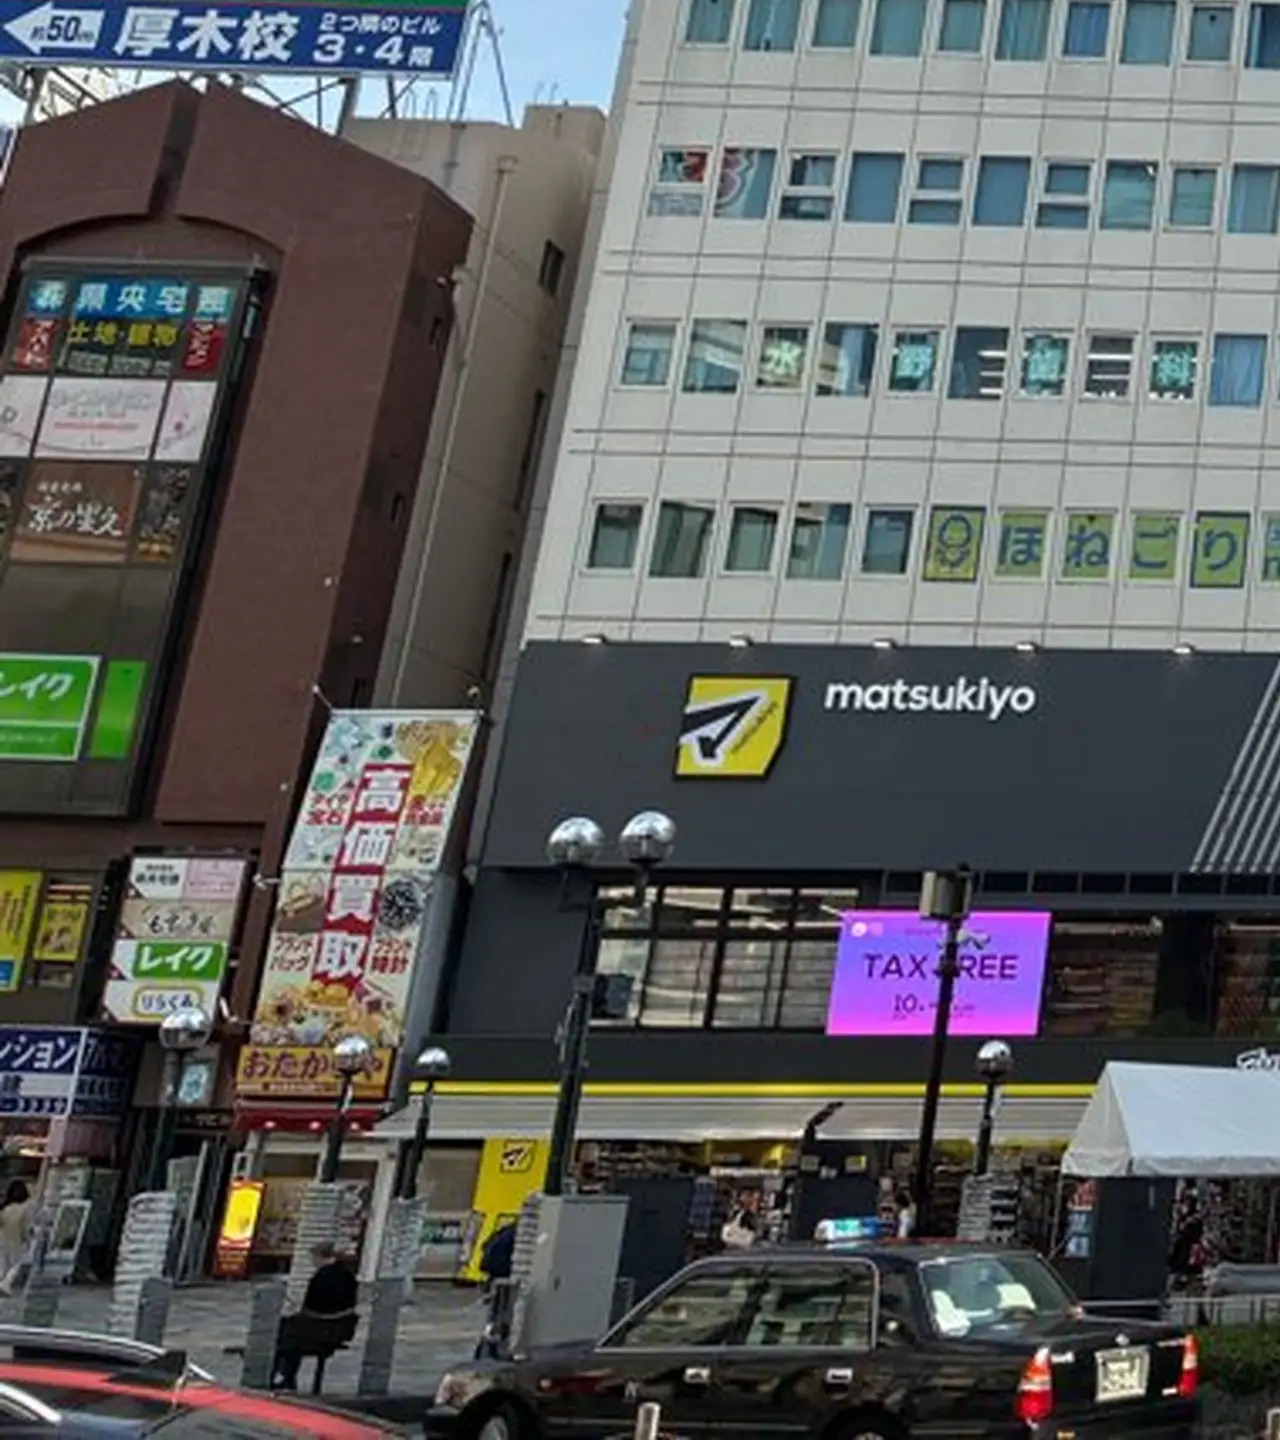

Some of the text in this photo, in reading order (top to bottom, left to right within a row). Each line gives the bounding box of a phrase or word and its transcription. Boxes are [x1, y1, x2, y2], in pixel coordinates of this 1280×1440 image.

[114, 6, 302, 62] 厚木校
[318, 12, 442, 35] 2つ隣のビル
[1000, 515, 1238, 572] ほねごり
[824, 676, 1036, 720] matsukiyo
[314, 769, 412, 980] 高価買取
[138, 945, 214, 971] レイク
[864, 953, 1020, 980] TAX REE
[243, 1050, 384, 1081] おたかや
